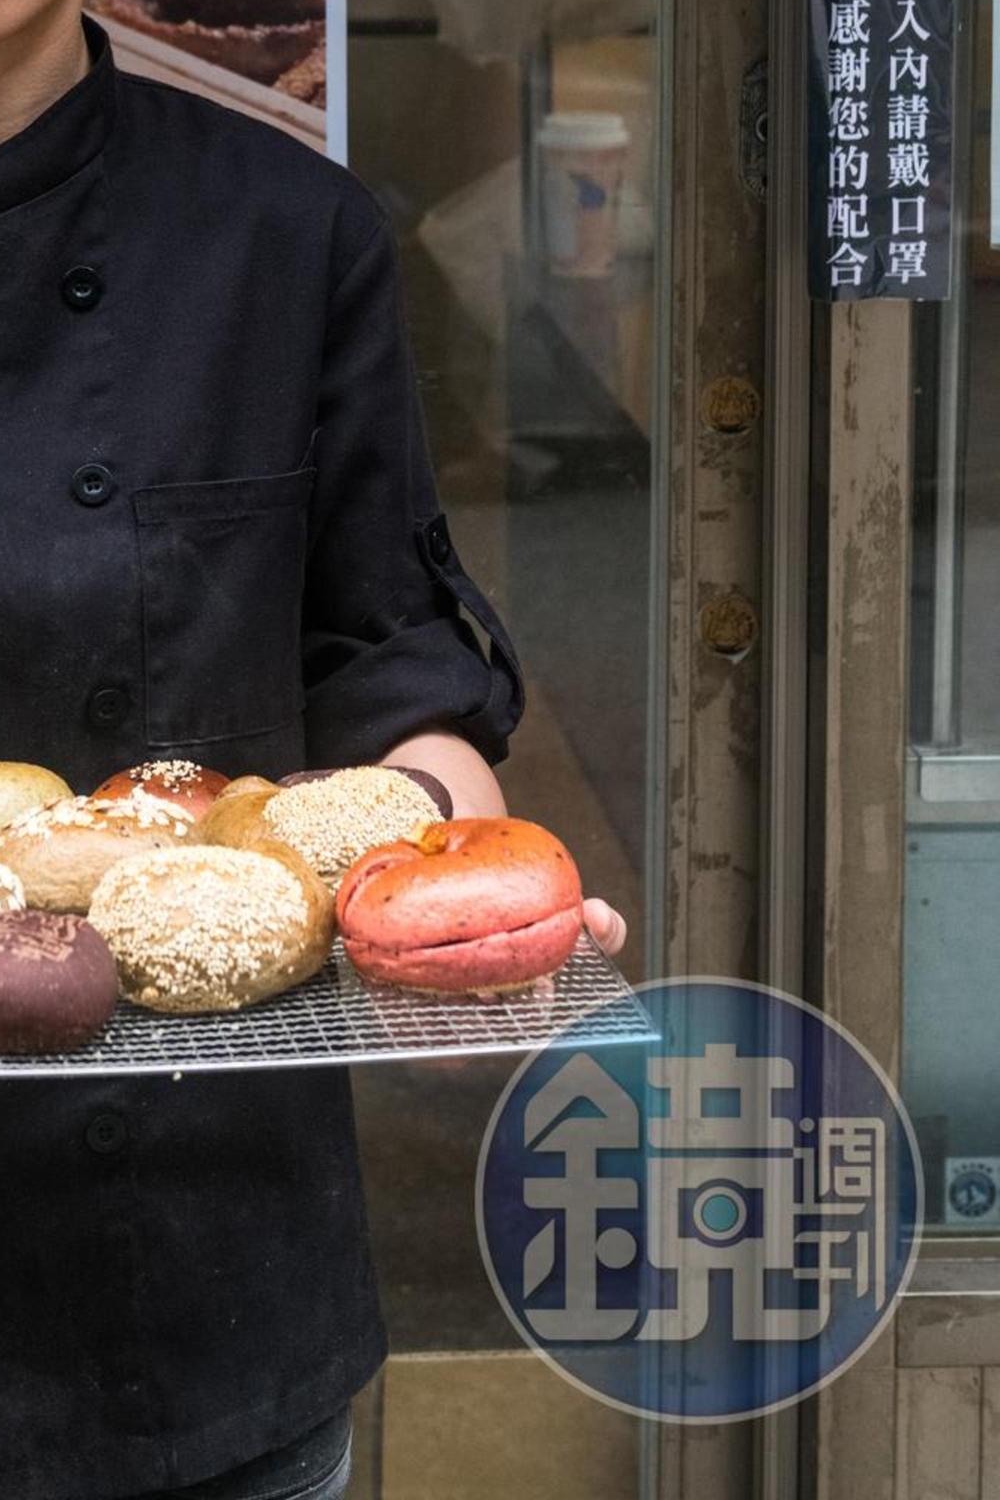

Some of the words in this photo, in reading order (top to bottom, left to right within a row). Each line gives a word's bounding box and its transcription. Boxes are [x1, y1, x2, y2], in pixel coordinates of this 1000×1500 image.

[886, 0, 931, 286] 入內請戴口罩
